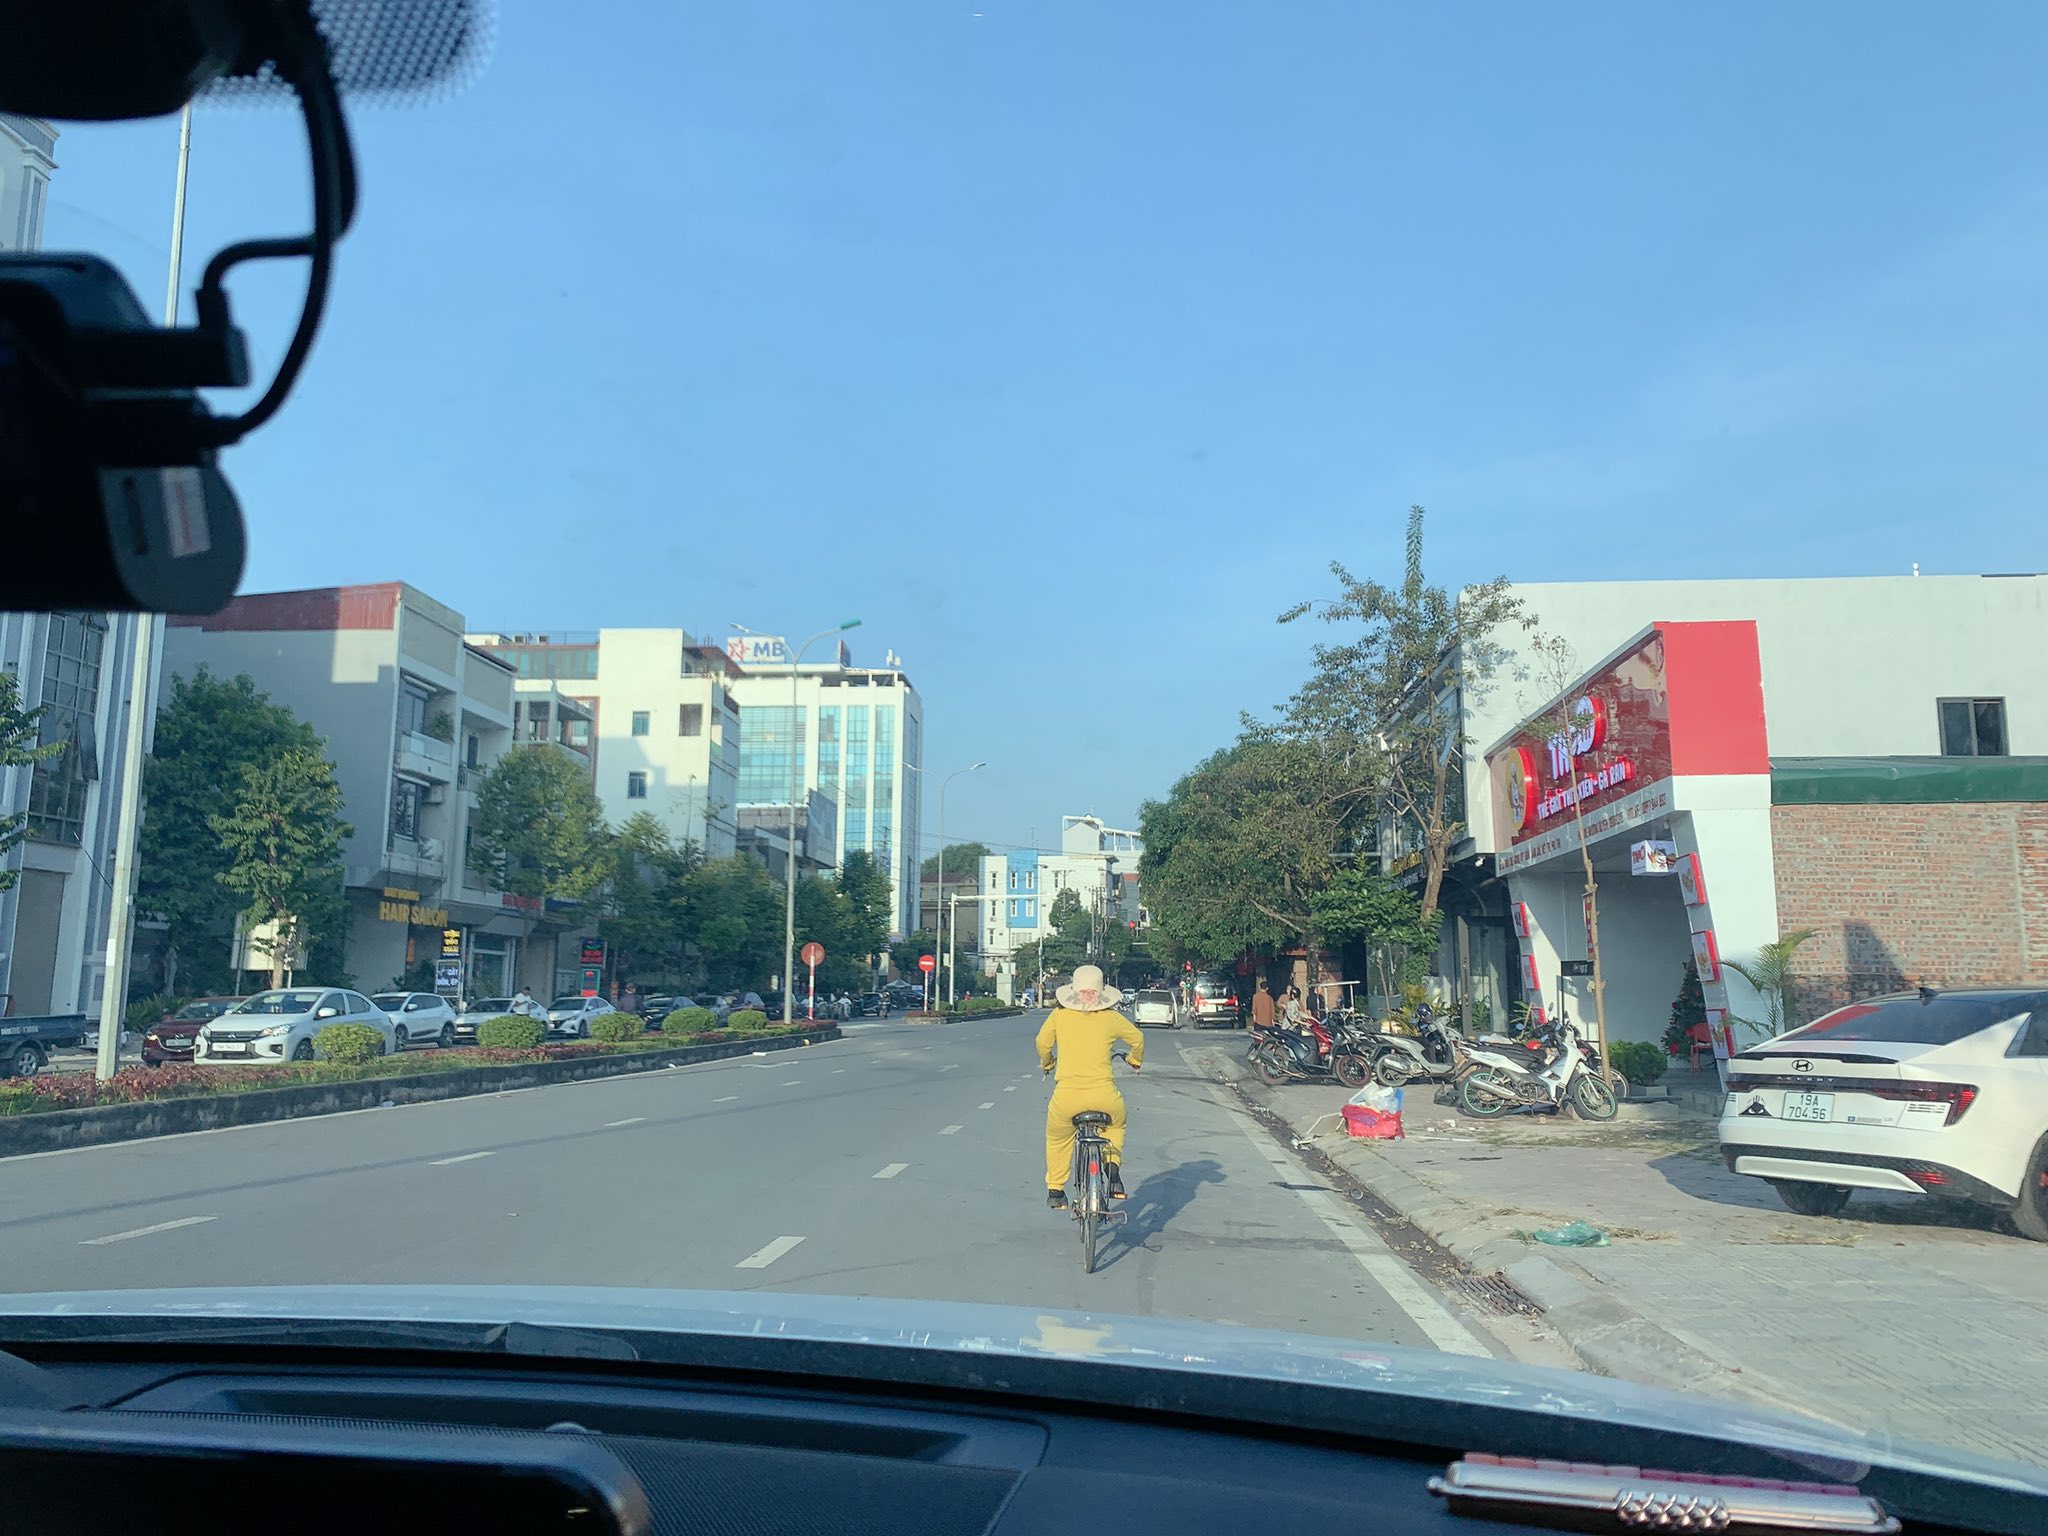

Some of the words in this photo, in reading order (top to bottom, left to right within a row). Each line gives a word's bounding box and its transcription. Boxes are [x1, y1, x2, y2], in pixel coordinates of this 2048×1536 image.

[753, 641, 785, 657] MB
[379, 900, 410, 924] HAIR
[410, 906, 448, 928] SALON
[1800, 1094, 1819, 1107] 19A
[1788, 1106, 1827, 1120] 704.56
